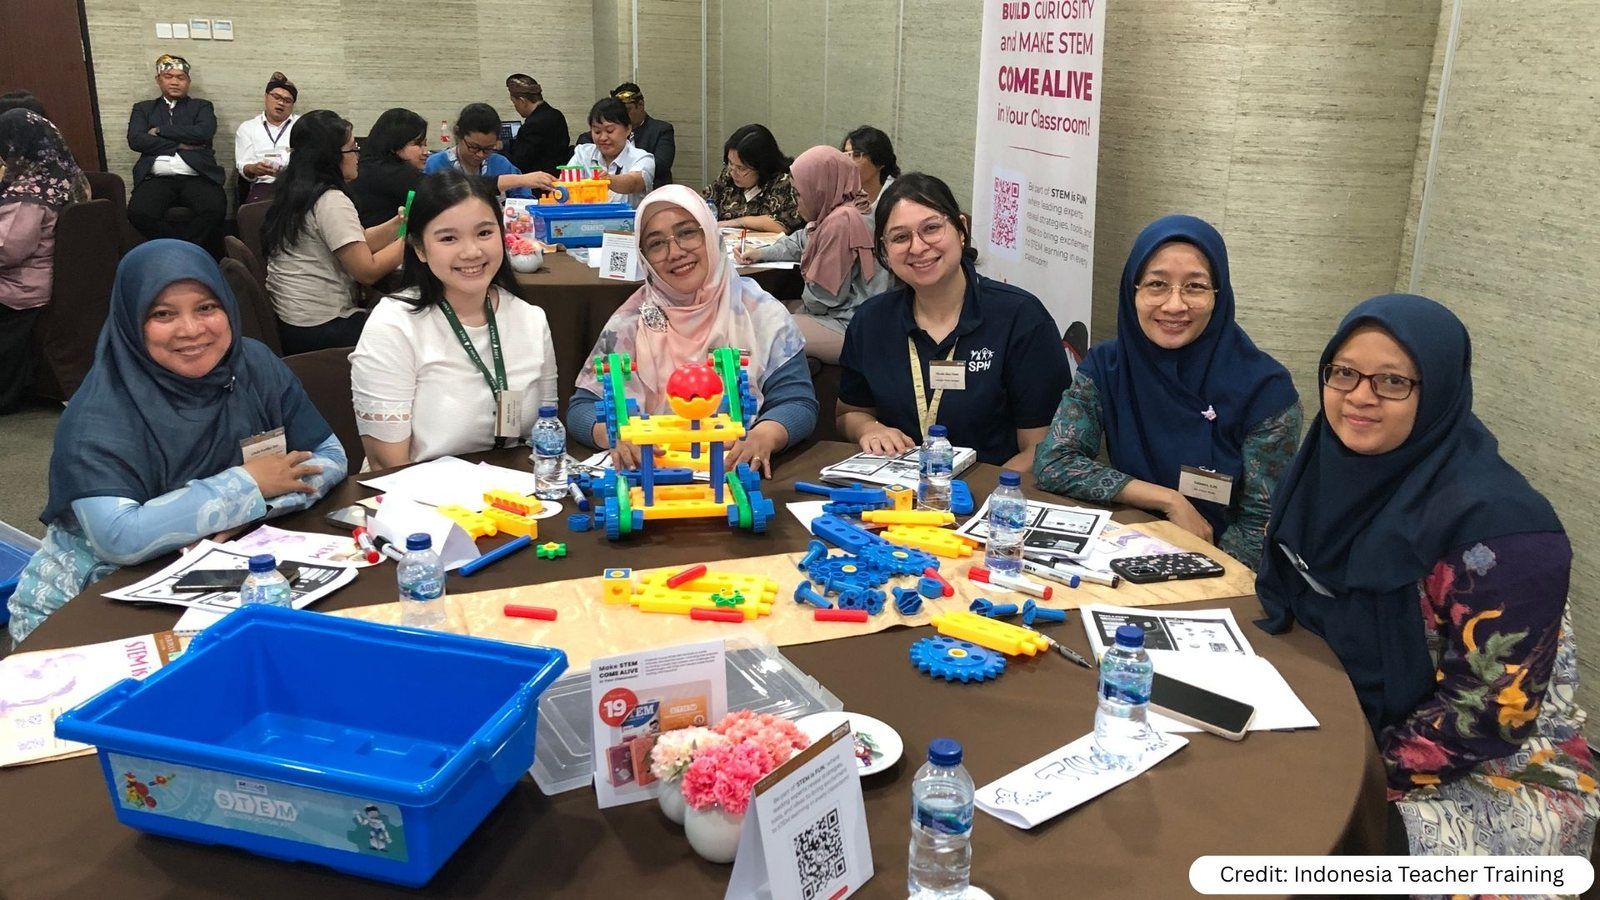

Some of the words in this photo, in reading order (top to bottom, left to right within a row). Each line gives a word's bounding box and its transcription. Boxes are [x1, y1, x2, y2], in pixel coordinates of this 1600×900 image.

[1002, 2, 1030, 20] BUILD
[1034, 0, 1094, 20] CURIOSITY
[1000, 31, 1017, 52] and
[1019, 31, 1054, 53] MAKE
[1059, 32, 1093, 55] STEM
[998, 65, 1039, 95] COME
[1041, 69, 1093, 101] ALIVE
[997, 103, 1005, 122] in
[1006, 105, 1029, 126] Your
[1031, 108, 1091, 136] Classroom!
[1051, 188, 1071, 200] STEM
[1071, 191, 1076, 202] is
[968, 360, 991, 373] SPH
[125, 641, 149, 667] STEM
[599, 671, 619, 679] COME
[619, 667, 639, 676] ALIVE
[619, 660, 638, 669] STEM
[603, 698, 627, 718] 19
[796, 775, 810, 788] STEM
[218, 793, 295, 819] STEM
